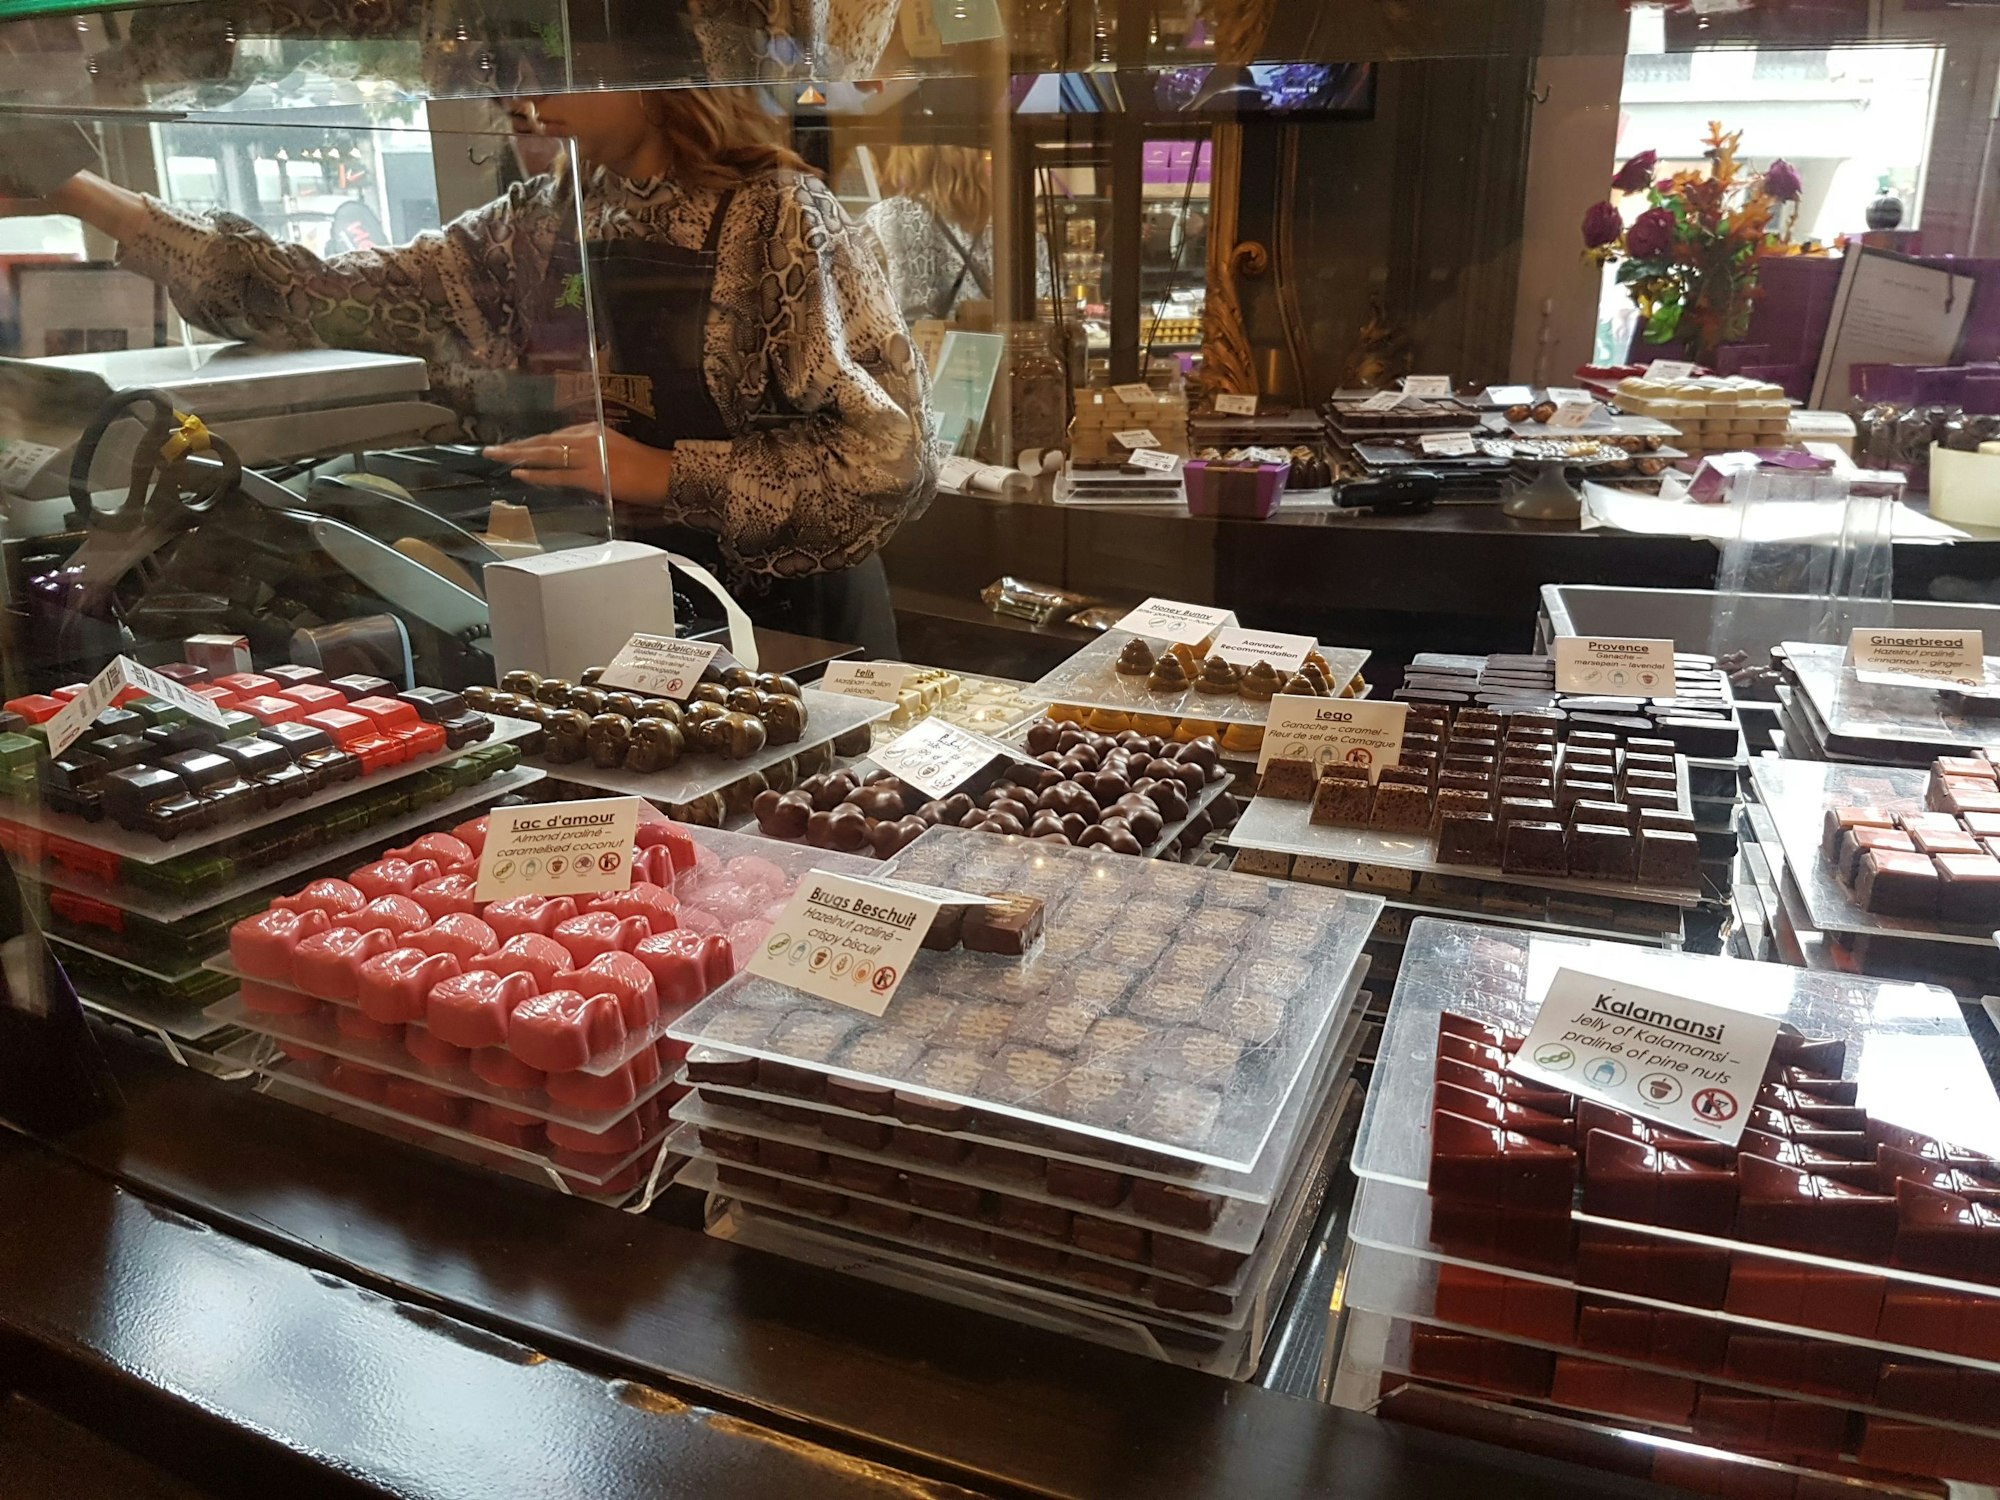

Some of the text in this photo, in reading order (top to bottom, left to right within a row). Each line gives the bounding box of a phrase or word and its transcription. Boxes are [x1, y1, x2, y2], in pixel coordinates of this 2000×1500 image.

[1150, 604, 1213, 621] Honey Bunny
[667, 643, 712, 656] Delicious
[1242, 639, 1284, 651] Aanrader
[1588, 641, 1649, 653] Provence
[1871, 635, 1963, 648] Gingerbread
[1219, 643, 1299, 660] Recommendation
[1596, 652, 1635, 660] Ganache
[1873, 647, 1918, 656] Hazelnut
[1919, 649, 1955, 657] praliné
[1628, 662, 1666, 670] lavendel
[1867, 657, 1919, 665] cinnamon
[1929, 660, 1963, 668] ginger
[1888, 666, 1953, 675] gingerbread
[855, 668, 875, 678] Felix
[1316, 708, 1353, 721] Lego
[1281, 720, 1328, 731] Ganache
[1338, 727, 1382, 736] caramel
[1268, 729, 1396, 748] Fleur de sel de Camargue
[512, 812, 615, 831] Lac d'amour
[512, 833, 560, 844] Almond
[561, 827, 603, 841] praliné
[496, 838, 625, 857] caramelised coconut
[809, 886, 917, 928] Brugs Beschuit
[802, 906, 854, 930] Hazelnut
[853, 920, 895, 942] praliné
[807, 926, 881, 956] crispy biscuit
[1593, 993, 1726, 1042] Kalamansi
[1571, 1012, 1611, 1033] Jelly
[1612, 1022, 1634, 1037] of
[1634, 1028, 1729, 1064] Kalamansi
[1560, 1030, 1732, 1085] praliné of pine nuts
